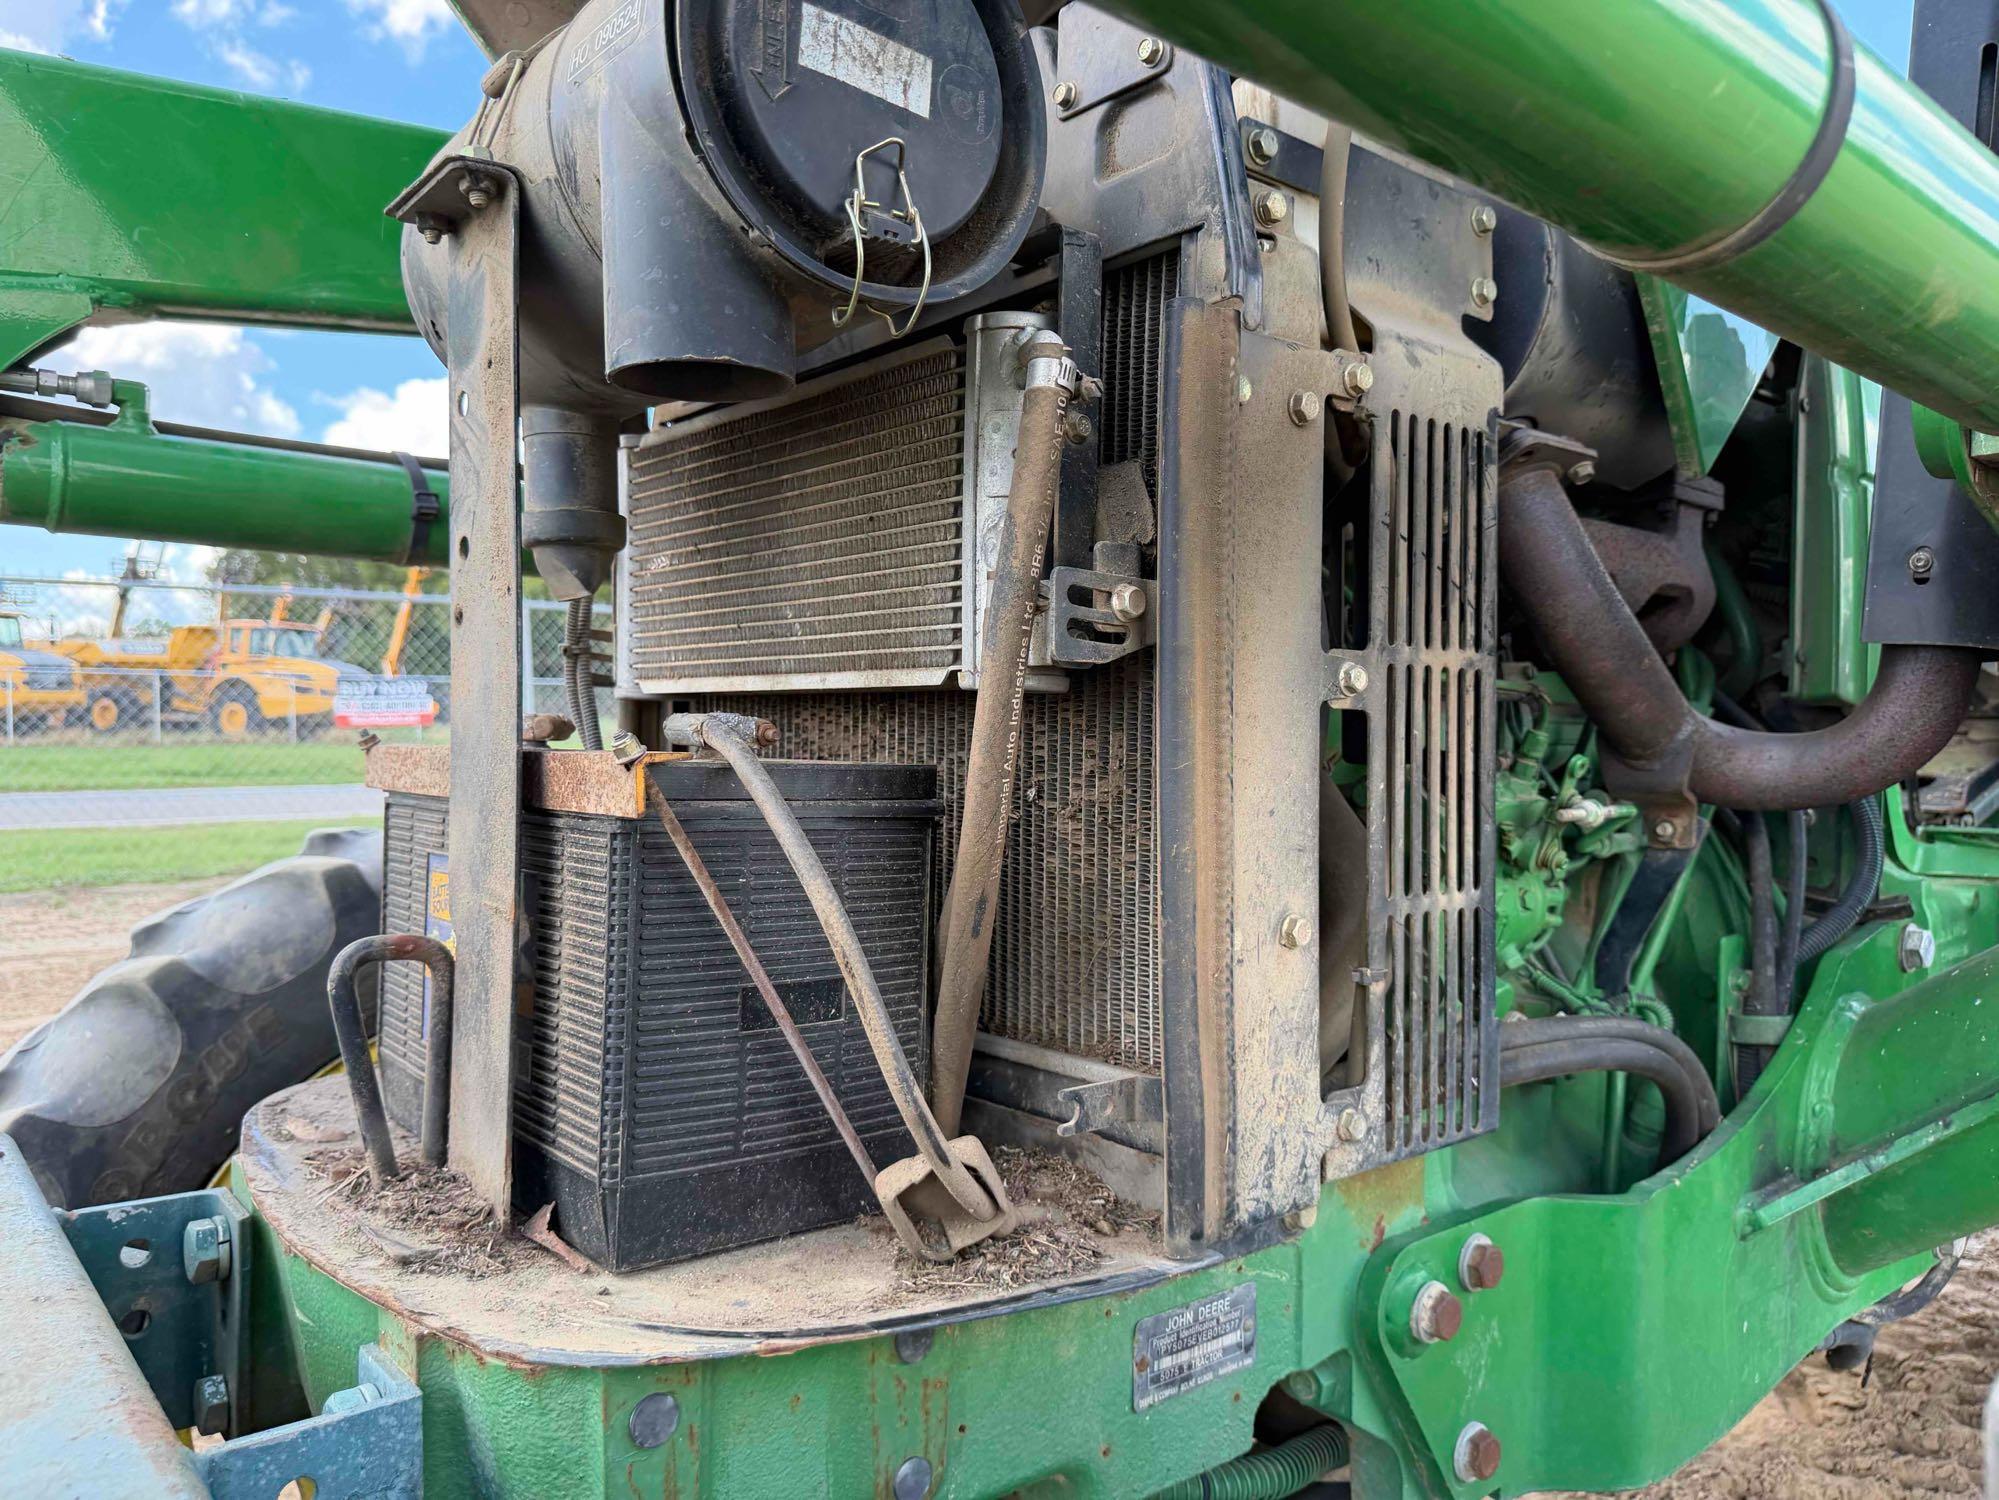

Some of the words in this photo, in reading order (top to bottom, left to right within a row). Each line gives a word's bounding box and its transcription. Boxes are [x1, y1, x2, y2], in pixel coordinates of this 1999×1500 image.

[595, 0, 638, 51] 090524
[1050, 422, 1064, 461] SAE
[1030, 544, 1044, 578] 8R6
[1022, 601, 1034, 630] Ltd
[1009, 637, 1029, 725] Industries
[1004, 731, 1016, 771] Auto
[1165, 1310, 1193, 1332] JOHN
[1198, 1297, 1231, 1320] DEERE
[1152, 1332, 1177, 1349] Product
[1179, 1319, 1217, 1338] Identification
[1160, 1366, 1180, 1382] 5075
[1191, 1348, 1224, 1369] TRACTOR
